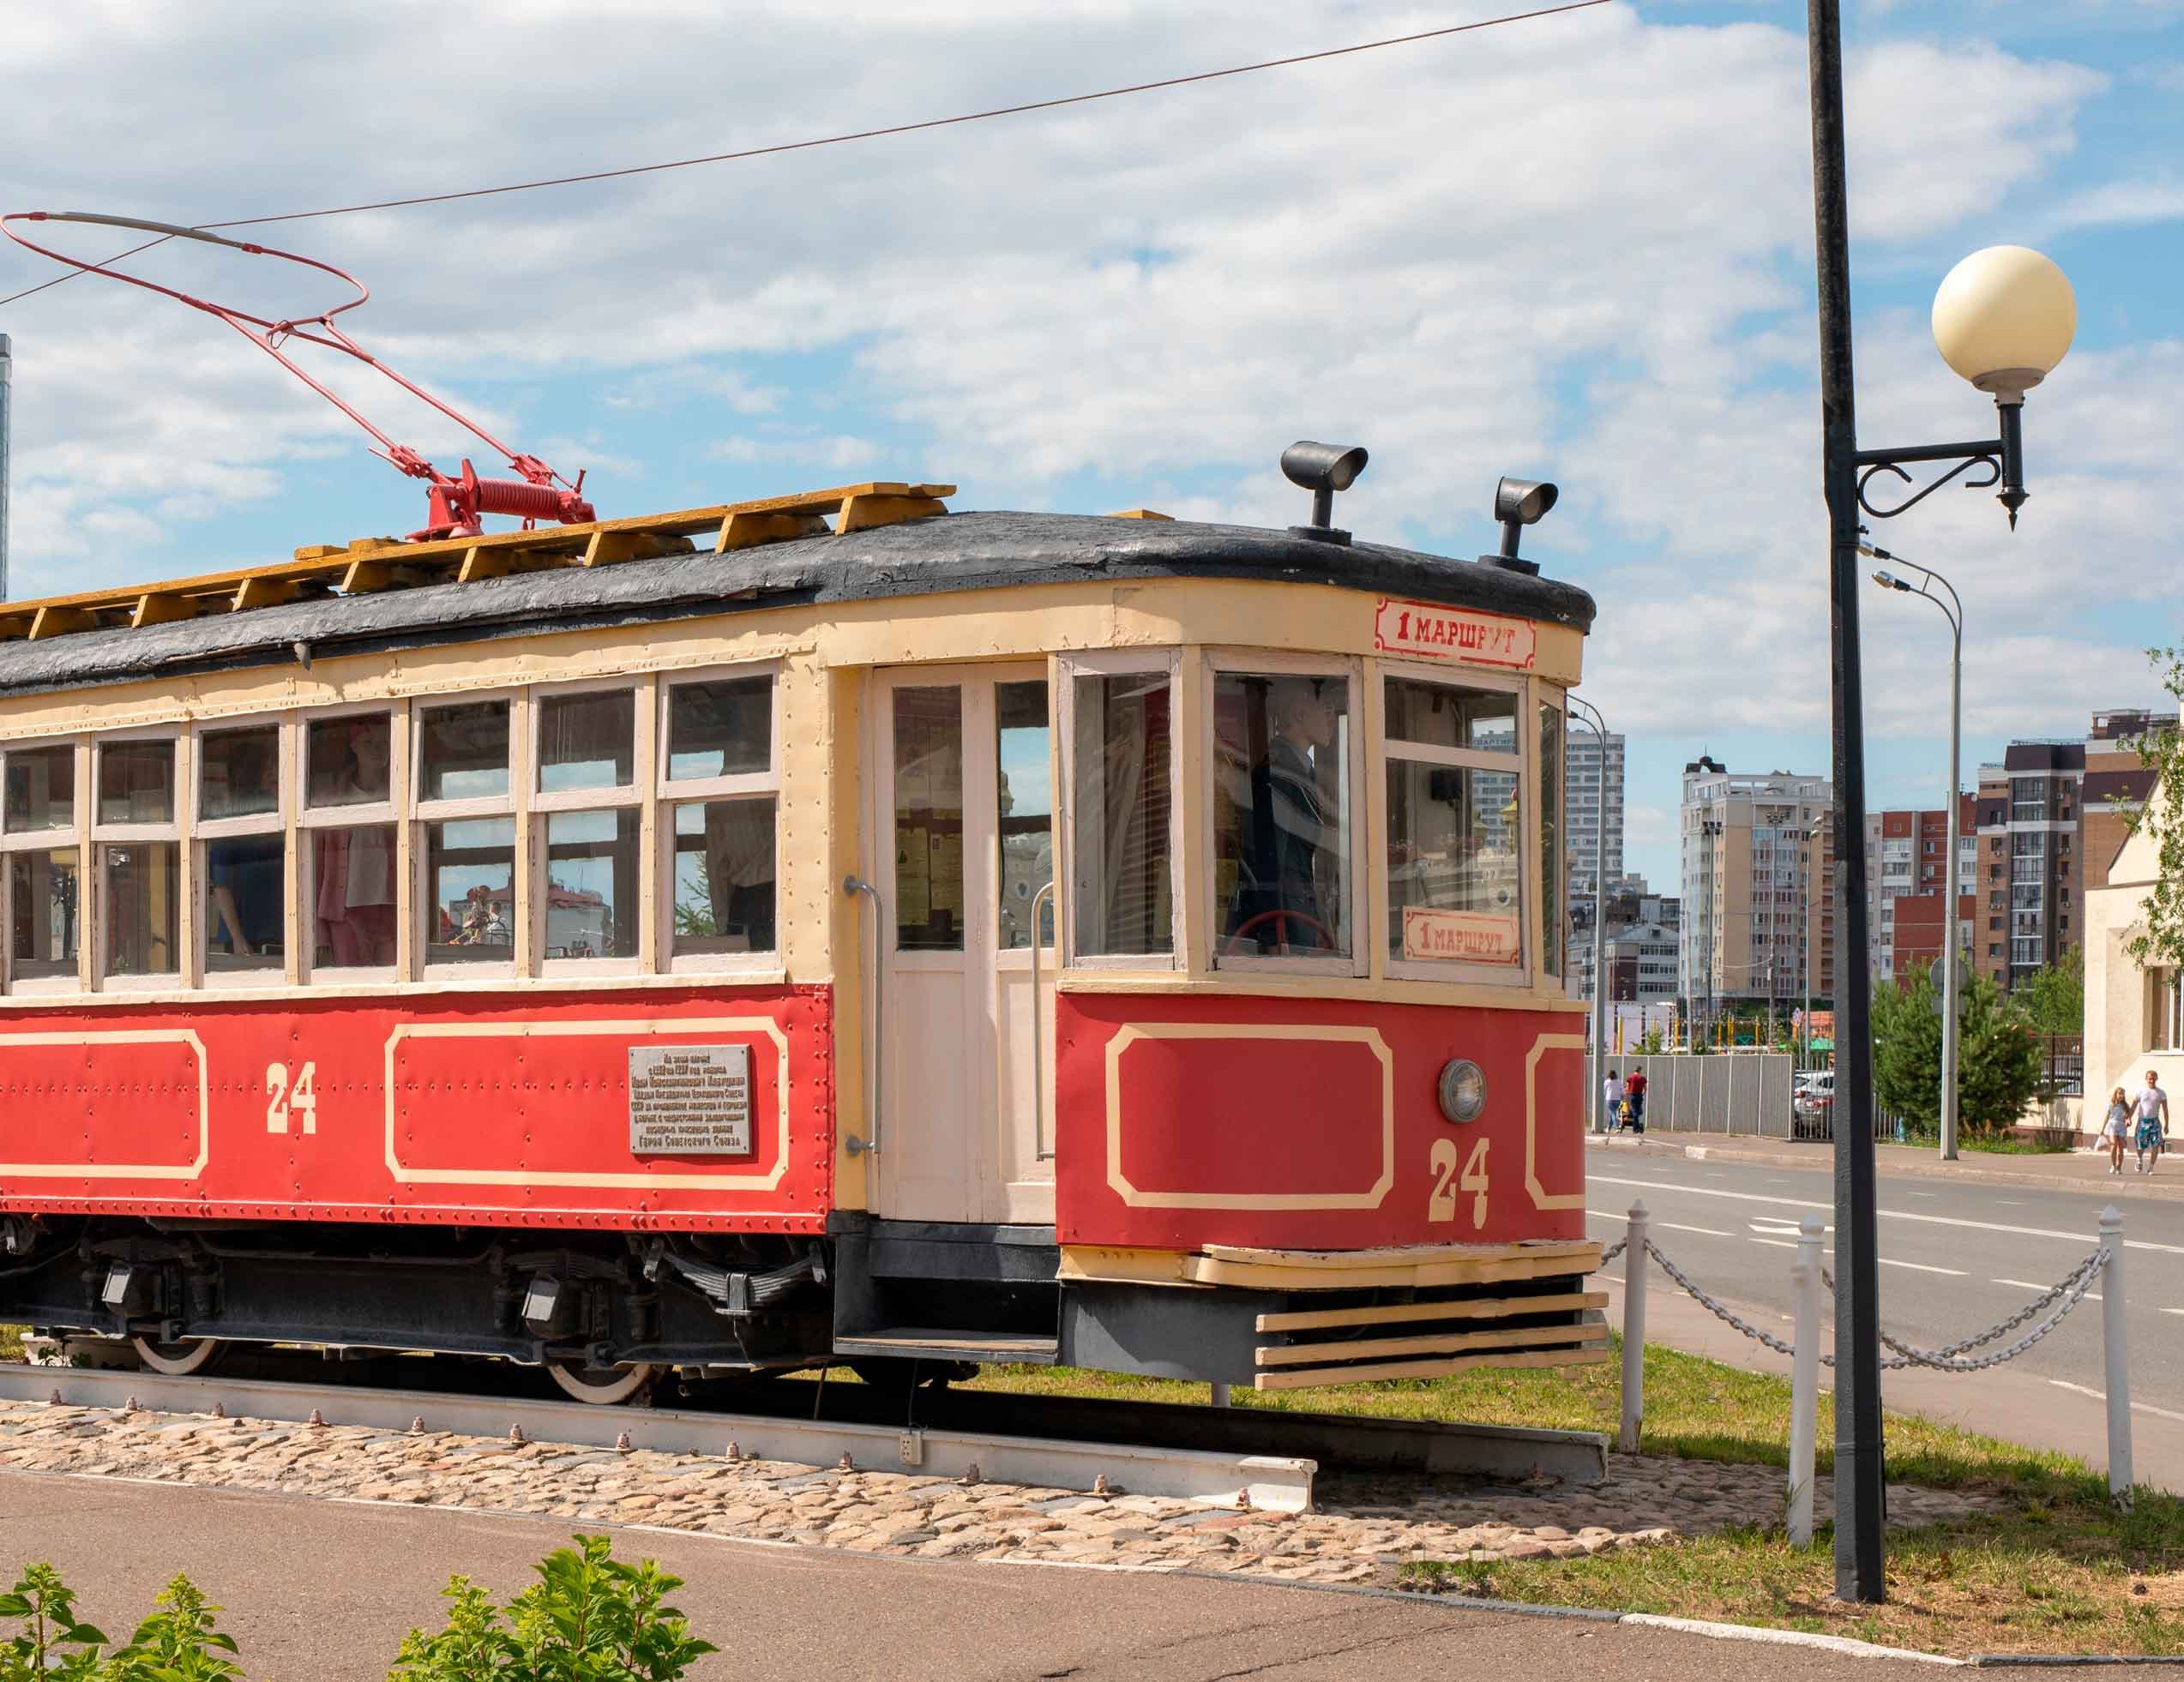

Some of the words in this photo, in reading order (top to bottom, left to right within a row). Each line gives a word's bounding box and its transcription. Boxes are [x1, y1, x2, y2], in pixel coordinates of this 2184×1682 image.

[1398, 611, 1411, 640] 1
[1420, 922, 1430, 950] 1
[1434, 928, 1503, 955] МАРШРУТ
[267, 1061, 316, 1134] 24
[1429, 1138, 1489, 1229] 24
